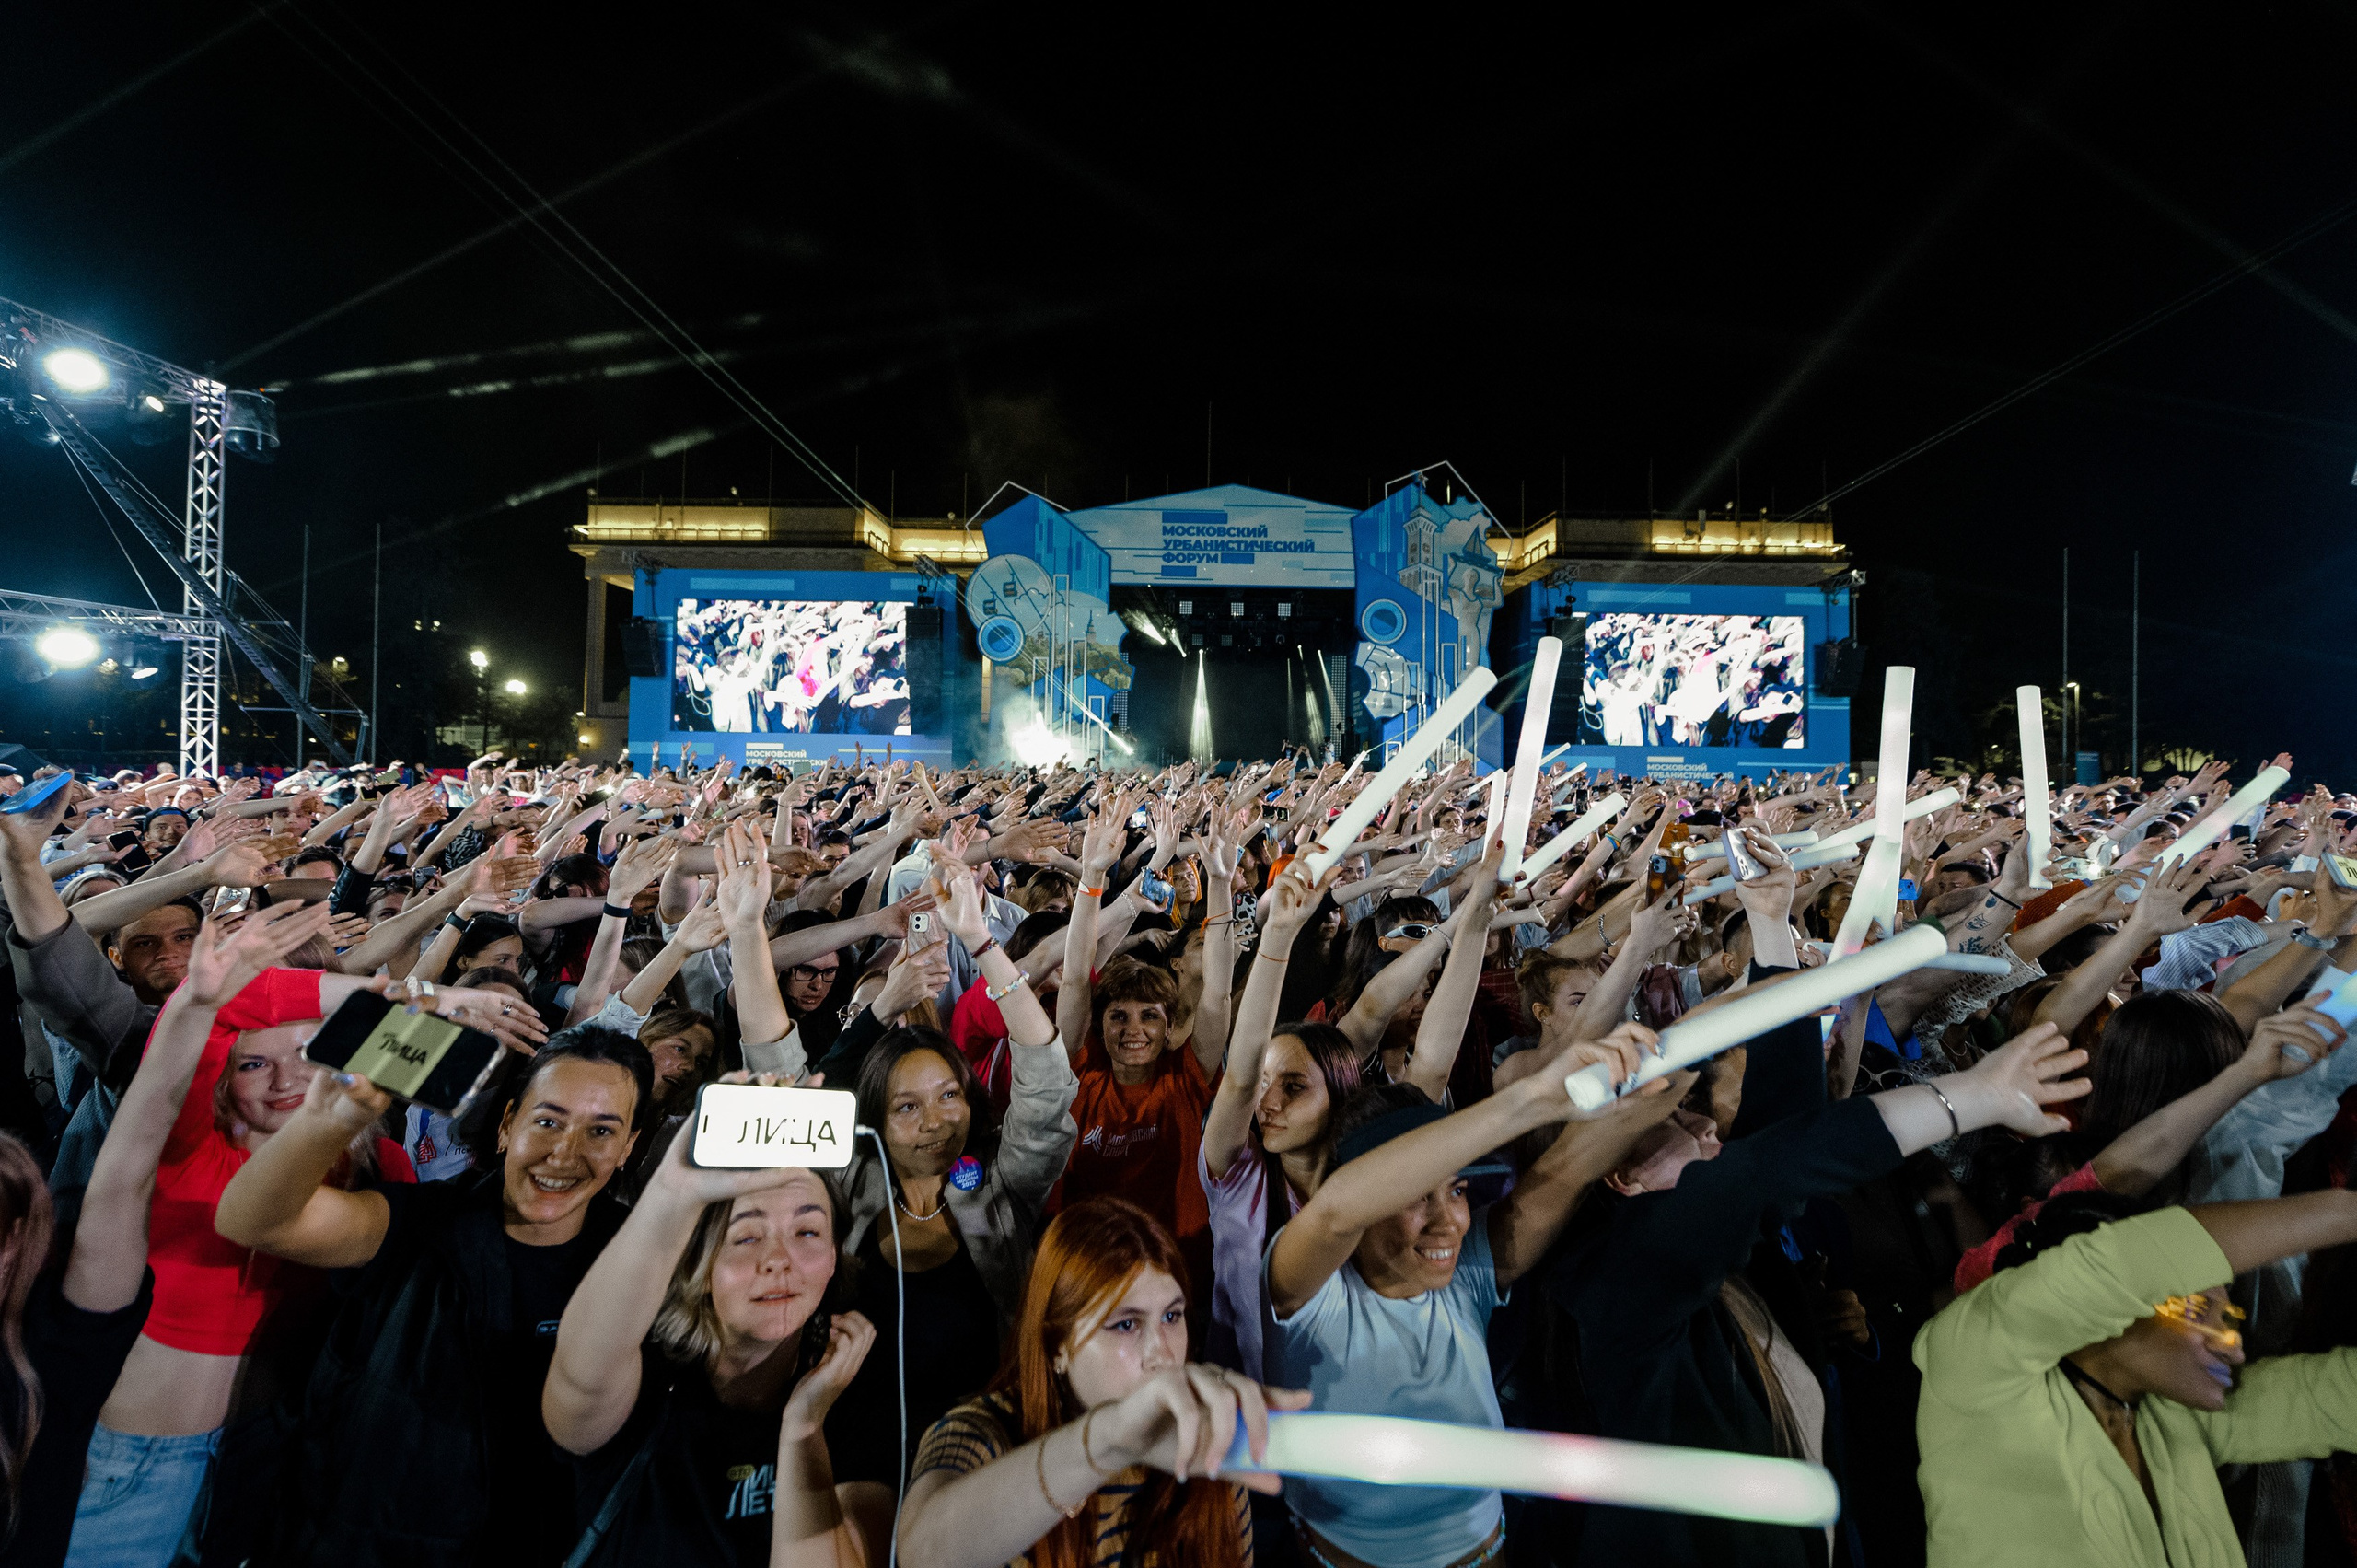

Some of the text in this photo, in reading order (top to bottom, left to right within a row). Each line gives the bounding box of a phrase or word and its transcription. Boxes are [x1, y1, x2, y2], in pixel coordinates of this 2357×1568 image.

[1162, 524, 1268, 538] МОСКОВСКИЙ
[1163, 539, 1315, 552] УРБАНИСТИЧЕСКИЙ
[1162, 552, 1219, 563] ФОРУМ
[746, 749, 807, 758] МОСКОВСКИЙ
[1647, 763, 1707, 772] МОСКОВСКИЙ
[737, 1117, 837, 1152] ЛИЦА
